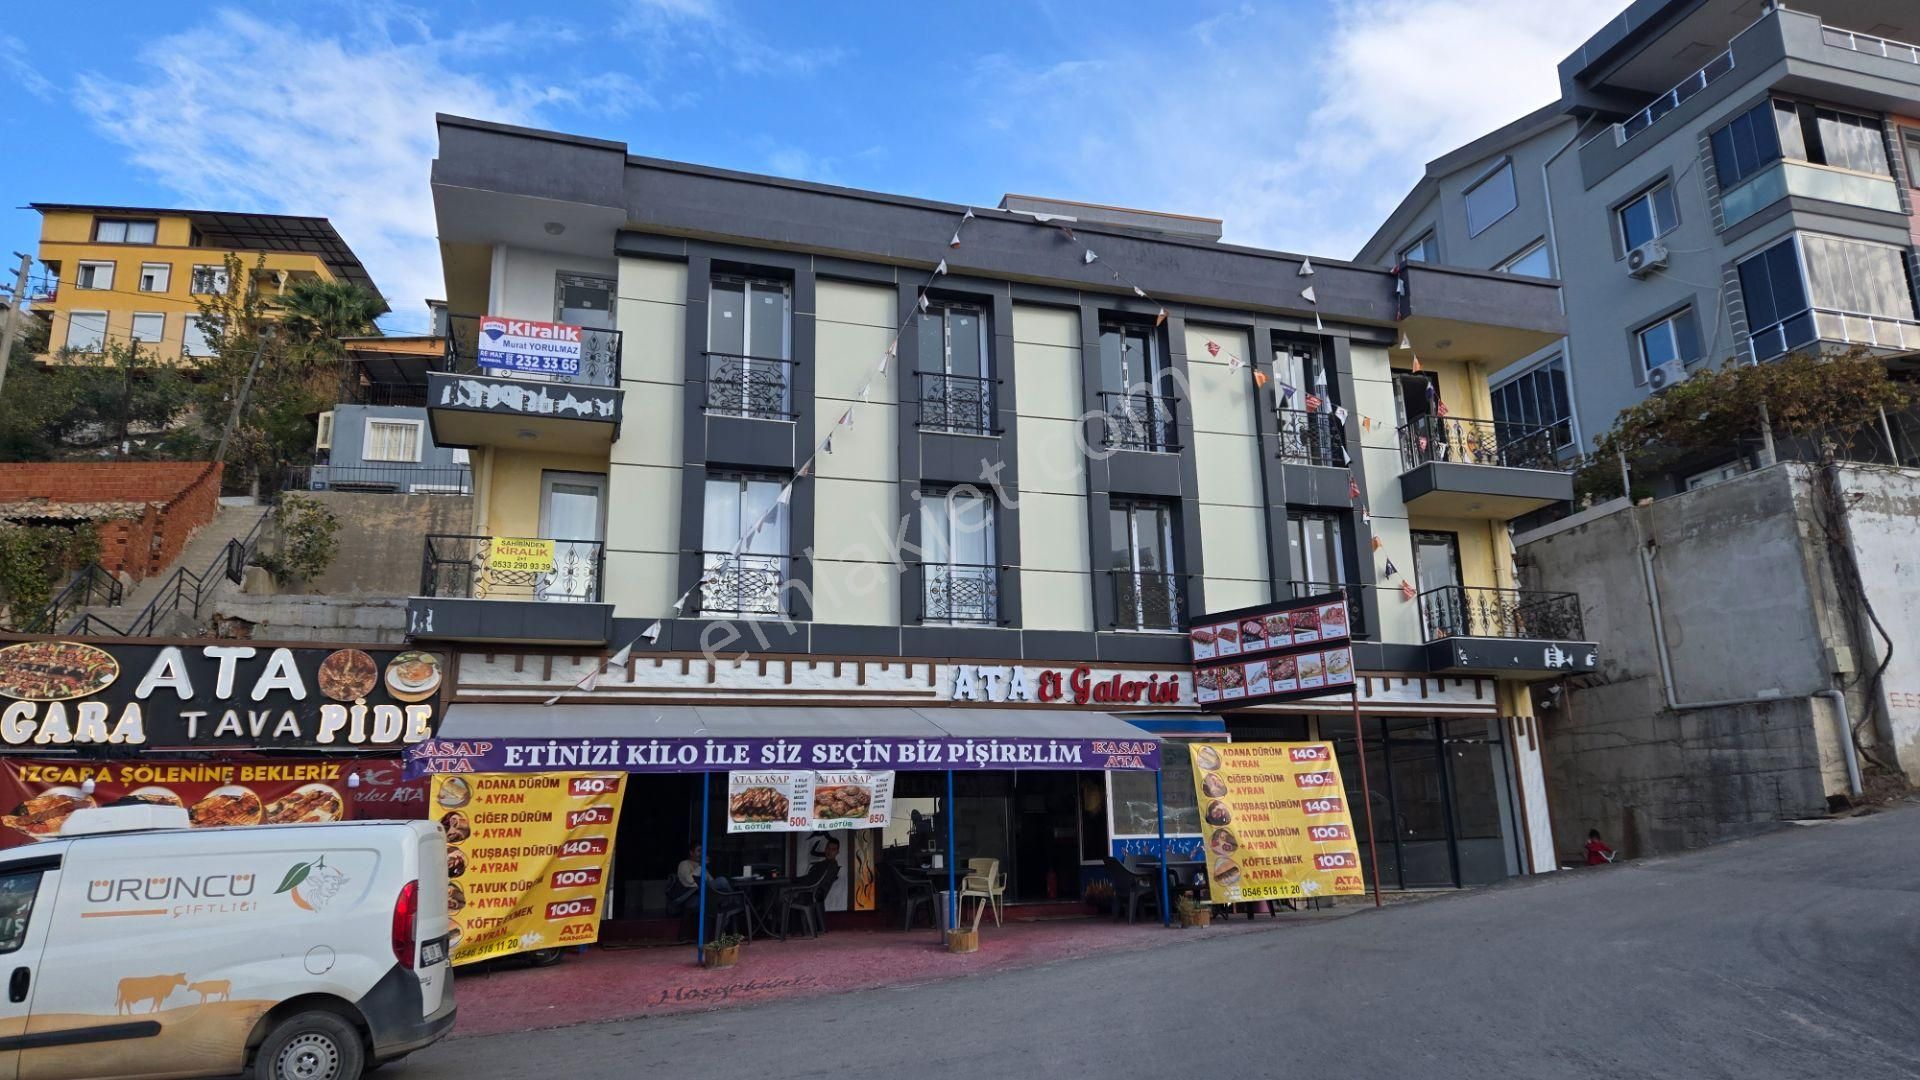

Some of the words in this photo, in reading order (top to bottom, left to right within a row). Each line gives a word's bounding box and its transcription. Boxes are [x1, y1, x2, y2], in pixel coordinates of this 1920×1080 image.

[508, 321, 579, 341] Kiralık
[503, 340, 527, 350] Murat
[529, 342, 578, 354] YORULMAZ
[480, 350, 503, 358] REMAX
[516, 354, 539, 367] 232
[542, 357, 559, 369] 33
[561, 359, 577, 370] 66
[501, 540, 545, 548] SAHİBİNDEN
[496, 546, 549, 557] KİRALIK
[492, 561, 512, 569] 0533
[513, 561, 528, 569] 290
[530, 562, 539, 570] 93
[541, 563, 551, 571] 39
[135, 645, 307, 701] ATA
[953, 664, 1033, 701] ATA
[1070, 664, 1181, 705] Galerisi
[1889, 692, 1920, 708] EE
[0, 700, 146, 744] GARA
[179, 709, 301, 739] TAVA
[316, 698, 433, 744] PİDE
[504, 739, 619, 767] ETİNİZİ
[625, 739, 699, 765] KİLO
[704, 739, 750, 765] İLE
[760, 739, 802, 764] SİZ
[811, 738, 892, 768] SEÇİN
[897, 739, 942, 763] BİZ
[949, 739, 1082, 768] PİŞİRELİM
[1092, 741, 1157, 755] KASAP
[1223, 748, 1251, 757] ADANA
[1252, 746, 1283, 757] DÜRÜM
[1292, 749, 1317, 760] 140
[423, 758, 474, 773] ATA
[1104, 755, 1145, 769] ATA
[1231, 760, 1260, 769] AYRAN
[19, 766, 113, 783] IZGARA
[120, 763, 235, 787] ŞÖLENİNE
[241, 762, 341, 782] BEKLERİZ
[732, 775, 753, 784] ATA
[755, 775, 790, 784] KASAP
[840, 774, 872, 784] KASAP
[1227, 773, 1252, 784] CİĞER
[1253, 773, 1285, 783] DÜRÜM
[1298, 774, 1324, 785] 140
[476, 778, 516, 789] ADANA
[518, 776, 560, 789] DÜRÜM
[573, 779, 604, 792] 140
[389, 787, 424, 802] ATA
[1236, 786, 1265, 795] AYRAN
[485, 794, 524, 804] AYRAN
[1232, 800, 1269, 812] KUŞBAŞI
[1269, 799, 1301, 809] DÜRÜM
[1305, 800, 1331, 811] 140
[474, 812, 508, 824] CİĞER
[510, 811, 552, 823] DÜRÜM
[572, 808, 597, 823] 140
[1241, 813, 1270, 822] AYRAN
[482, 827, 522, 838] AYRAN
[1238, 829, 1266, 839] TAVUK
[1267, 827, 1300, 837] DÜRÜM
[1312, 827, 1339, 838] 100
[471, 847, 520, 860] KUŞBAŞI
[522, 844, 561, 856] DÜRÜM
[562, 841, 592, 854] 140
[1247, 841, 1278, 850] AYRAN
[1242, 856, 1271, 867] KÖFTE
[1272, 855, 1303, 865] EKMEK
[1318, 855, 1345, 866] 100
[470, 865, 478, 873] +
[479, 862, 518, 873] AYRAN
[556, 872, 587, 885] 100
[1252, 869, 1283, 880] AYRAN
[1334, 876, 1361, 886] ATA
[87, 873, 256, 903] ÜRÜNCÜ
[469, 883, 508, 894] TAVUK
[1242, 886, 1262, 897] 0546
[1263, 885, 1278, 896] 518
[1280, 884, 1289, 895] 11
[1291, 884, 1300, 894] 20
[172, 901, 257, 918] ÇİFTLİĞİ
[477, 897, 517, 909] AYRAN
[550, 902, 581, 916] 100
[474, 927, 508, 943] AYRAN
[559, 923, 594, 936] ATA
[558, 934, 594, 942] MANGAL
[455, 947, 476, 960] 0546
[477, 944, 494, 957] 518
[495, 941, 505, 951] 11
[507, 938, 519, 949] 20
